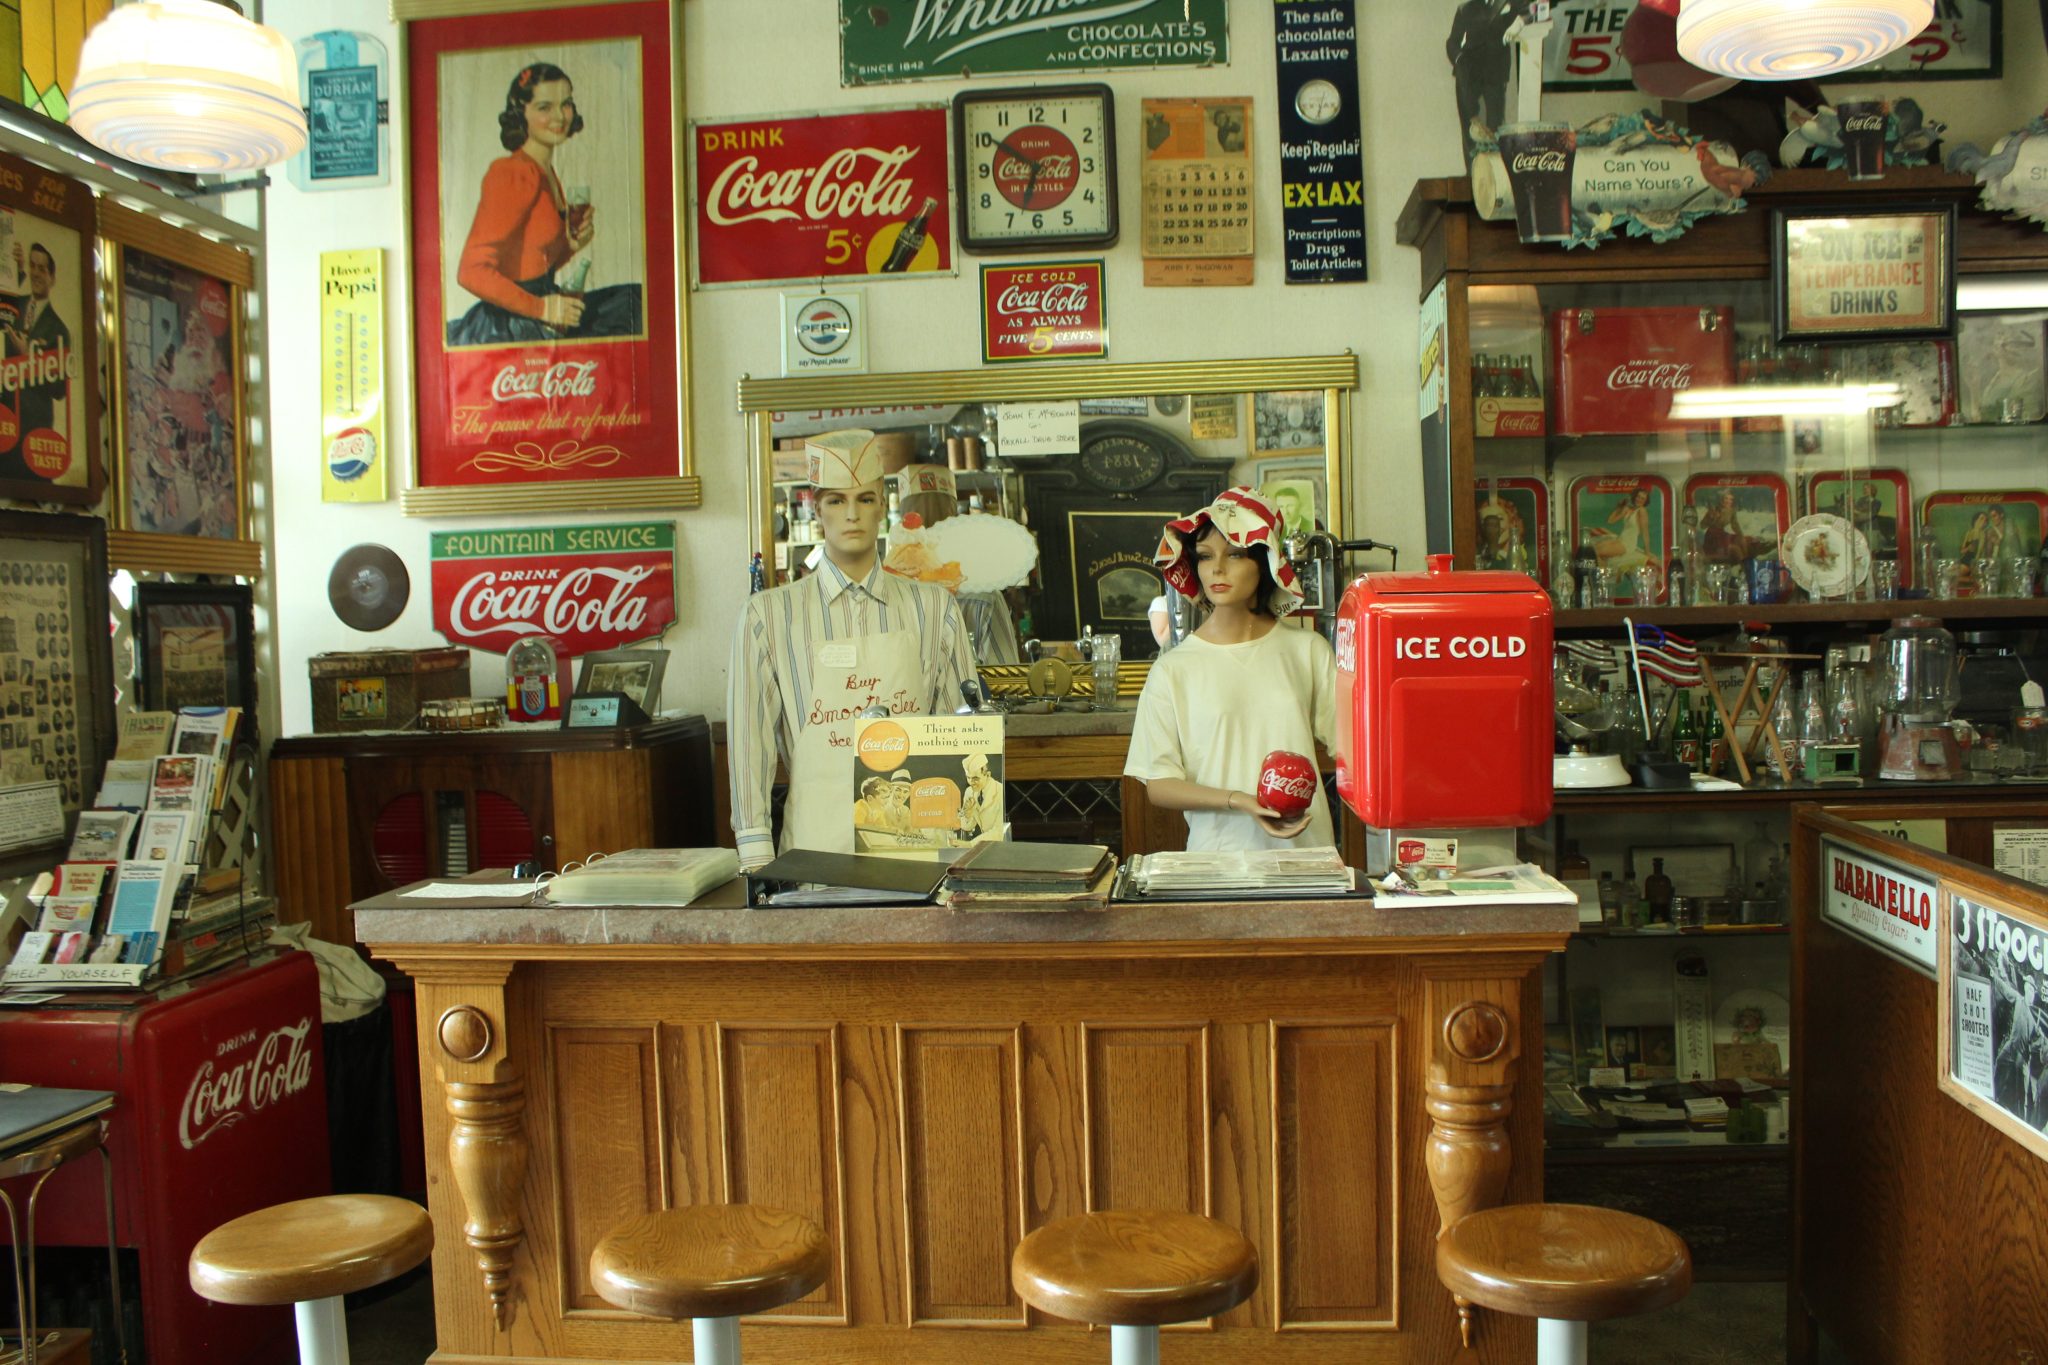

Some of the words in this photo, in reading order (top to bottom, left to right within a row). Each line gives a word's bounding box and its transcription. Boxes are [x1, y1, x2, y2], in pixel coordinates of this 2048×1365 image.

[1283, 10, 1311, 24] The
[1313, 8, 1344, 23] safe
[1564, 8, 1629, 34] THE
[1067, 21, 1207, 43] CHOCOLATES
[1277, 26, 1355, 43] chocolated
[1046, 52, 1077, 63] AND
[1078, 41, 1216, 61] CONFECTIONS
[1281, 47, 1349, 62] Laxative
[859, 64, 895, 75] SINCE
[998, 110, 1009, 126] 11
[1029, 107, 1045, 123] 12
[1062, 108, 1067, 124] 1
[703, 127, 784, 152] DRINK
[975, 132, 993, 148] 10
[1083, 127, 1093, 144] 2
[1020, 140, 1051, 148] DRINK
[1281, 142, 1312, 160] Keep
[1083, 157, 1095, 173] 3
[1308, 162, 1334, 174] with
[1512, 151, 1567, 174] Coca-Cola
[1604, 160, 1635, 174] Can
[1639, 159, 1671, 172] You
[978, 163, 990, 179] 9
[1180, 172, 1187, 181] 2
[1194, 172, 1201, 181] 3
[1209, 171, 1216, 181] 4
[1224, 171, 1230, 181] 5
[1238, 171, 1245, 181] 6
[705, 145, 921, 226] Coca-Cola
[1010, 184, 1020, 193] IN
[1165, 188, 1172, 197] 8
[1180, 188, 1187, 197] 9
[1193, 187, 1203, 197] 10
[1207, 188, 1217, 197] 11
[1222, 187, 1233, 196] 12
[1236, 187, 1247, 196] 13
[1585, 179, 1632, 193] Name
[980, 193, 992, 209] 8
[1083, 188, 1096, 204] 4
[1283, 180, 1363, 208] EX-LAX
[1164, 203, 1174, 213] 15
[1178, 203, 1189, 213] 16
[1193, 203, 1204, 212] 17
[1207, 203, 1218, 212] 18
[1222, 203, 1233, 211] 19
[1236, 202, 1248, 211] 20
[1004, 212, 1015, 229] 7
[1031, 213, 1044, 229] 6
[1062, 210, 1074, 226] 5
[1163, 219, 1175, 229] 22
[1177, 219, 1189, 229] 23
[1192, 219, 1204, 228] 24
[1207, 219, 1219, 228] 25
[1221, 218, 1234, 227] 26
[1236, 218, 1248, 227] 27
[1163, 235, 1175, 245] 29
[1177, 235, 1190, 244] 30
[1193, 235, 1204, 244] 31
[1287, 228, 1362, 241] Prescriptions
[1305, 243, 1346, 258] Drugs
[330, 266, 361, 276] Have
[363, 266, 372, 275] a
[1290, 258, 1320, 271] Toilet
[1320, 257, 1363, 270] Articles
[1010, 273, 1034, 284] ICE
[1040, 271, 1076, 283] COLD
[1803, 261, 1923, 290] TEMPERANCE
[325, 278, 377, 299] Pepsi
[996, 282, 1089, 316] Coca-Cola
[1829, 289, 1899, 315] DRINKS
[800, 321, 848, 335] PEPSI
[1007, 317, 1024, 328] AS
[1030, 315, 1082, 327] ALWAYS
[998, 333, 1029, 344] FIVE
[1028, 325, 1056, 354] 5
[1054, 330, 1094, 342] CENTS
[491, 359, 600, 402] Coca-Cola
[1606, 363, 1695, 391] Coca-Cola
[453, 402, 493, 435] The
[483, 415, 534, 444] pause
[536, 410, 572, 430] that
[572, 403, 642, 441] refreshes
[28, 437, 67, 456] BETTER
[31, 453, 63, 471] TASTE
[444, 530, 555, 556] FOUNTAIN
[567, 526, 657, 551] SERVICE
[499, 568, 560, 582] DRINK
[450, 564, 656, 637] Coca-Cola
[1396, 636, 1441, 660] ICE
[1448, 635, 1527, 660] COLD
[845, 673, 882, 692] Buy
[923, 722, 956, 734] Thirst
[961, 722, 984, 733] asks
[828, 730, 853, 748] Ice
[917, 736, 959, 747] nothing
[1261, 767, 1315, 801] Coca-Cola
[1834, 856, 1932, 932] HABANELLO
[1850, 900, 1880, 931] Quality
[1881, 915, 1909, 942] Cigars
[1957, 899, 1971, 944] 3
[1976, 906, 2048, 975] STOOG
[10, 967, 48, 979] HELP
[60, 968, 133, 980] YOURSELF
[1965, 987, 1983, 1002] HALF
[1963, 1002, 1986, 1020] SHOT
[1961, 1018, 1990, 1038] SHOOTERS
[216, 1027, 258, 1057] DRINK
[178, 1015, 315, 1150] Coca-Cola
